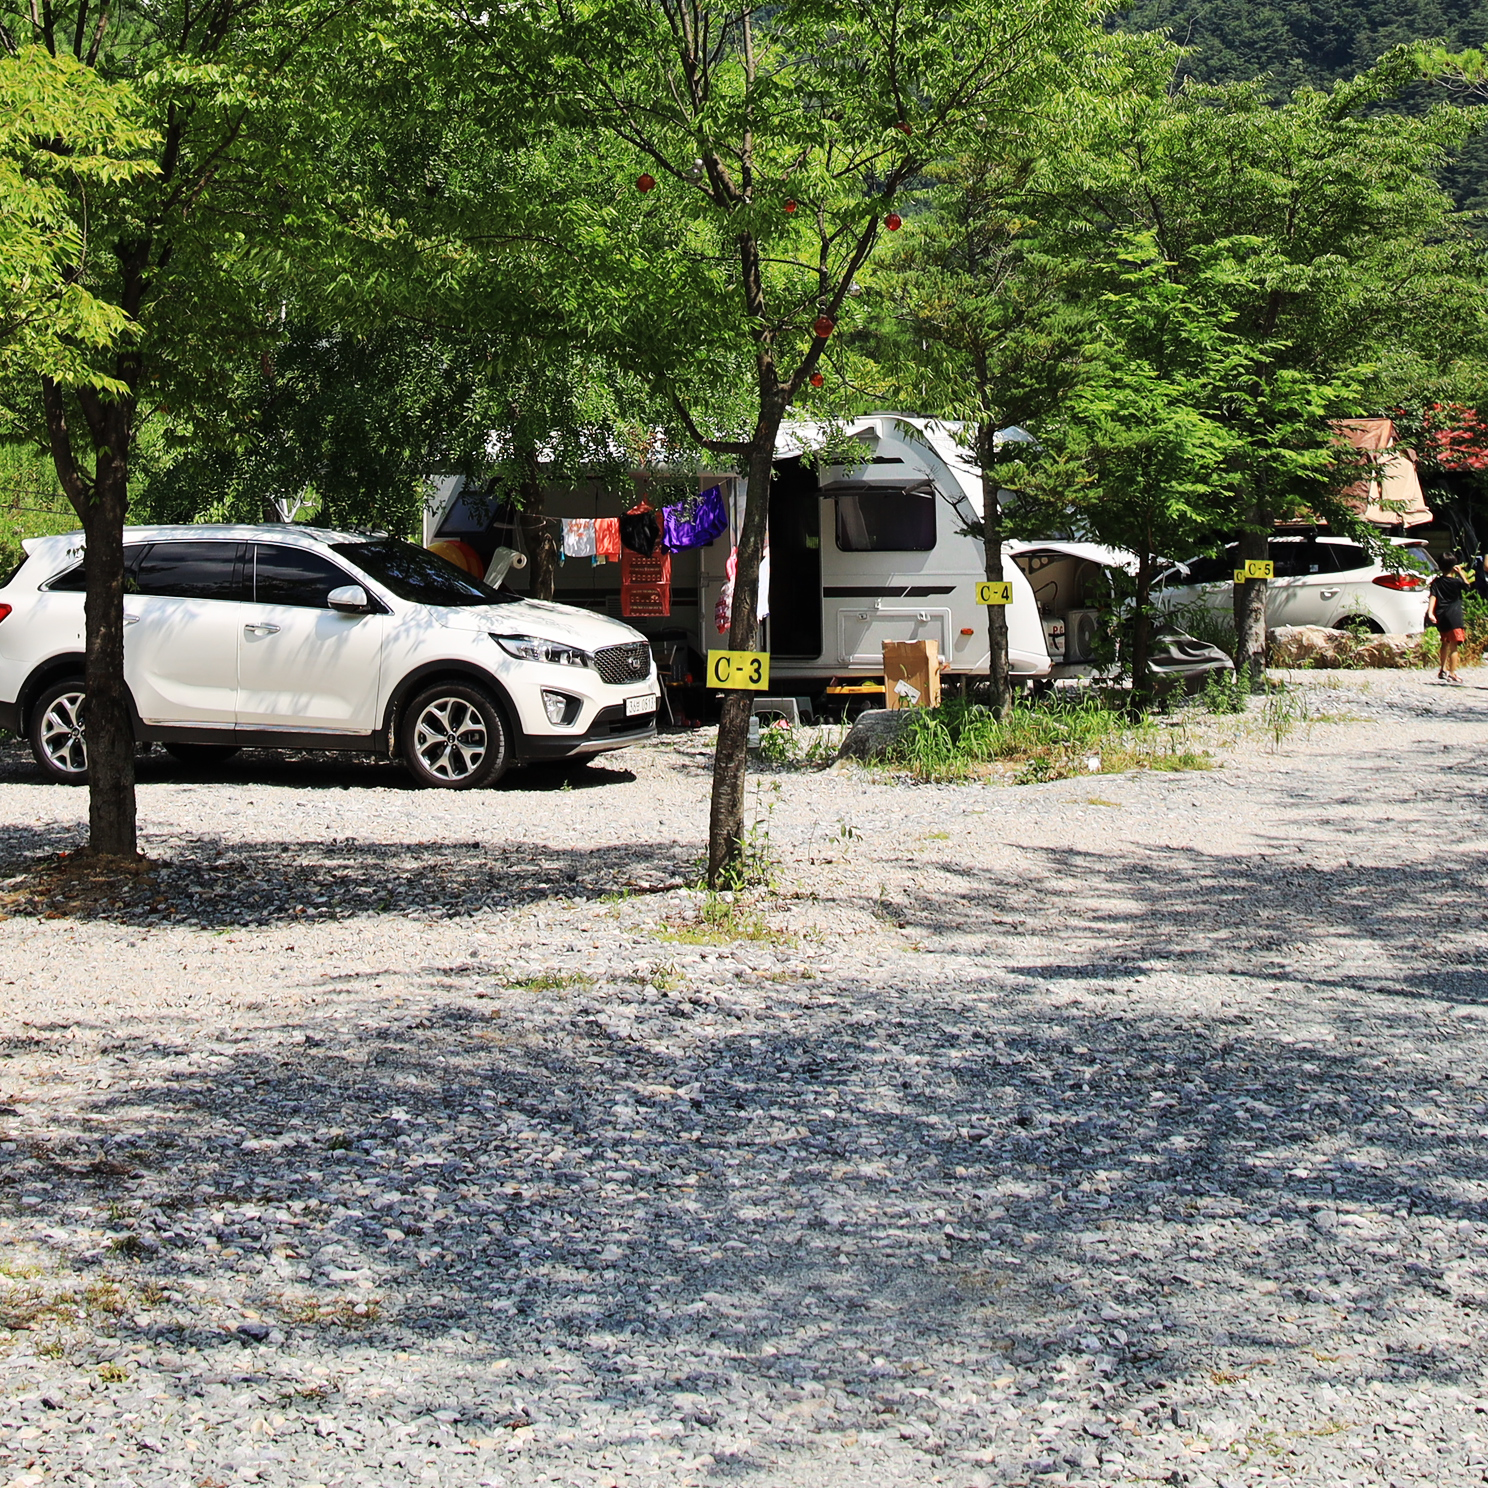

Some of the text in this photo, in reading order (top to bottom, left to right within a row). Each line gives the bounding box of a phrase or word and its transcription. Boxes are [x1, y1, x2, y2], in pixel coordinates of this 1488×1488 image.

[1248, 563, 1271, 576] C-5
[980, 585, 1010, 602] C-4
[714, 656, 762, 684] C-3
